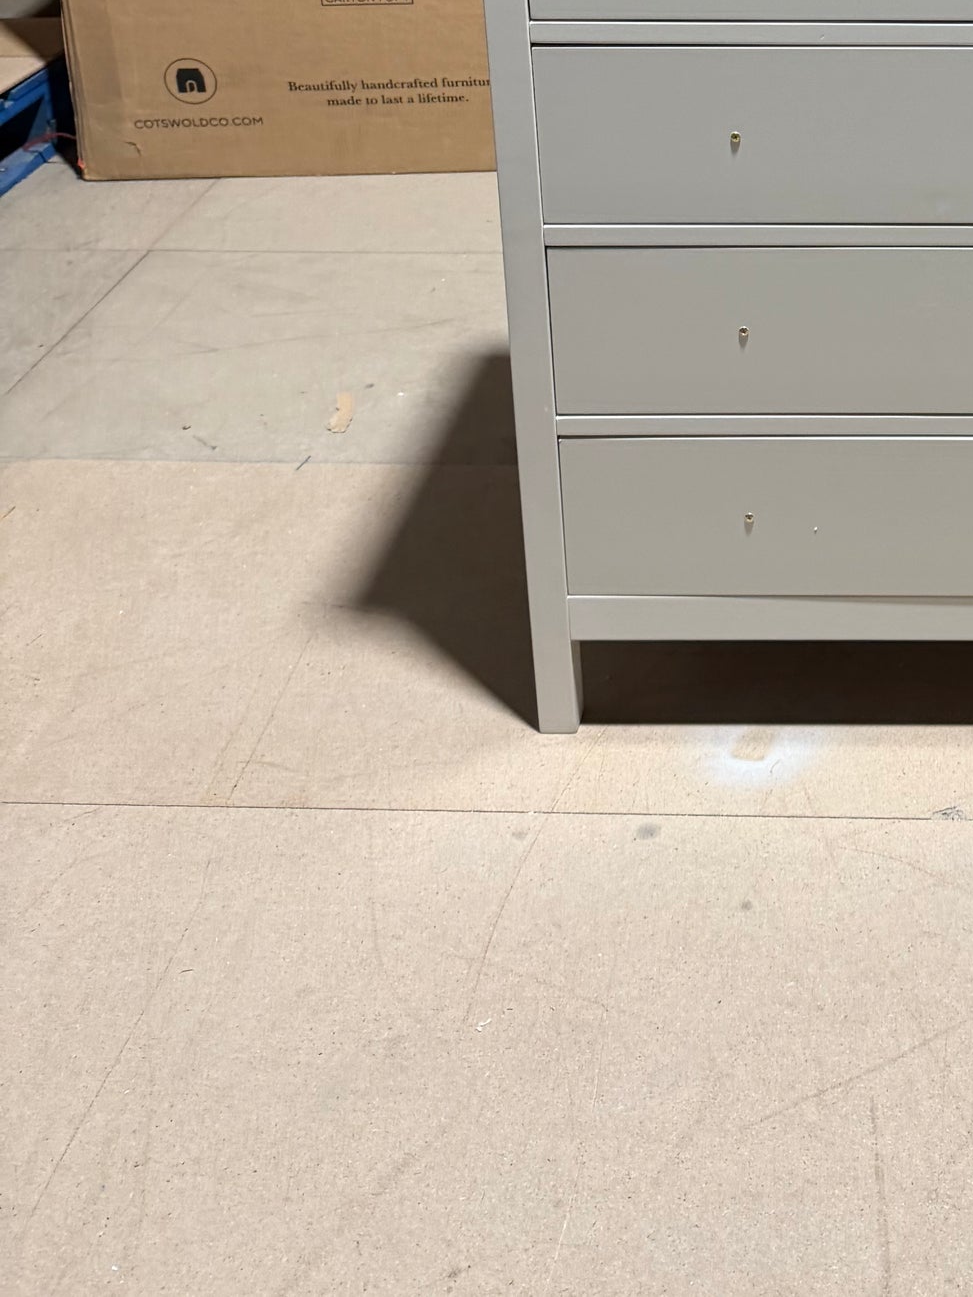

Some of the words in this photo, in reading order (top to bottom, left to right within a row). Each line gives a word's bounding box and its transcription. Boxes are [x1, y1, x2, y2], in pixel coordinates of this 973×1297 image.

[288, 80, 358, 92] Beautifully
[361, 78, 438, 90] handcrafted
[441, 76, 490, 88] furnitur
[327, 95, 362, 106] made
[365, 96, 378, 105] to
[381, 94, 403, 105] last
[407, 96, 414, 104] a
[418, 93, 469, 104] lifetime.
[134, 116, 264, 130] COTSWOLDCO.COM
